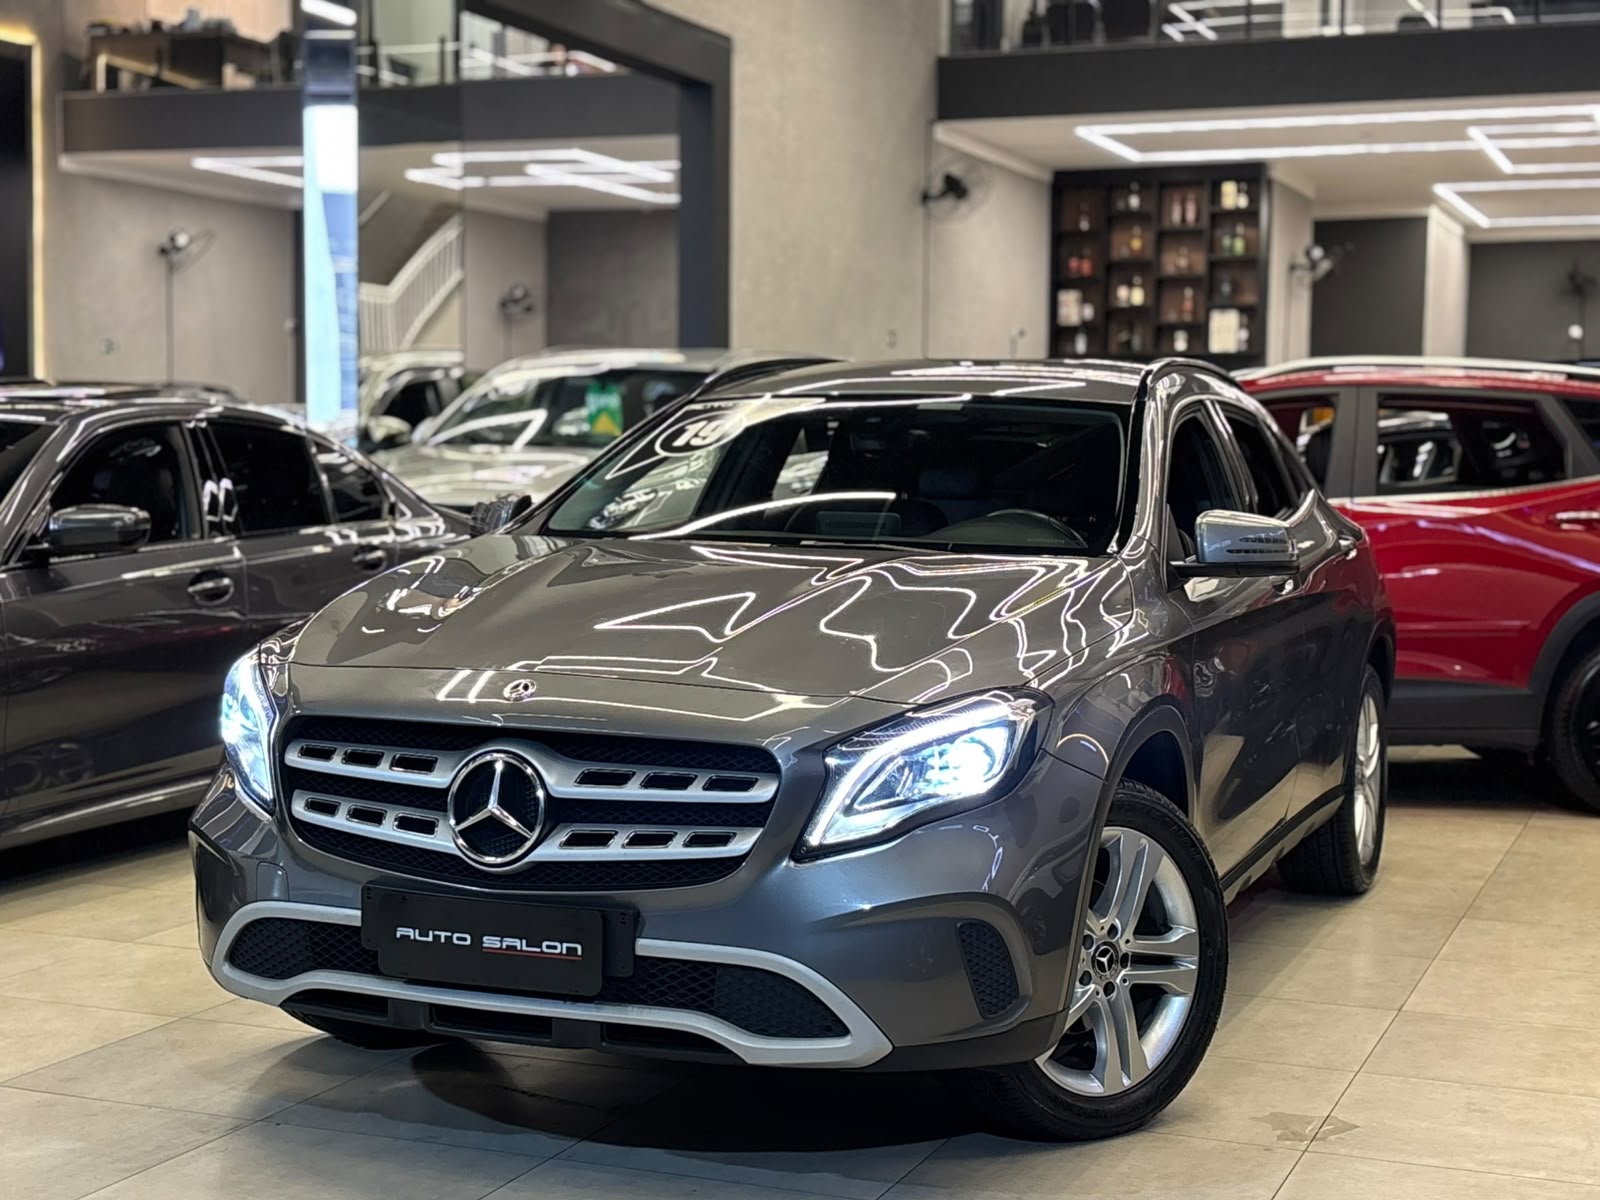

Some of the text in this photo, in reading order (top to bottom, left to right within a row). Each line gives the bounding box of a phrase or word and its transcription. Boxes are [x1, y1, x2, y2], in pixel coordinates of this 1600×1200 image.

[672, 420, 728, 446] 19
[396, 927, 582, 956] AUTO SALON
